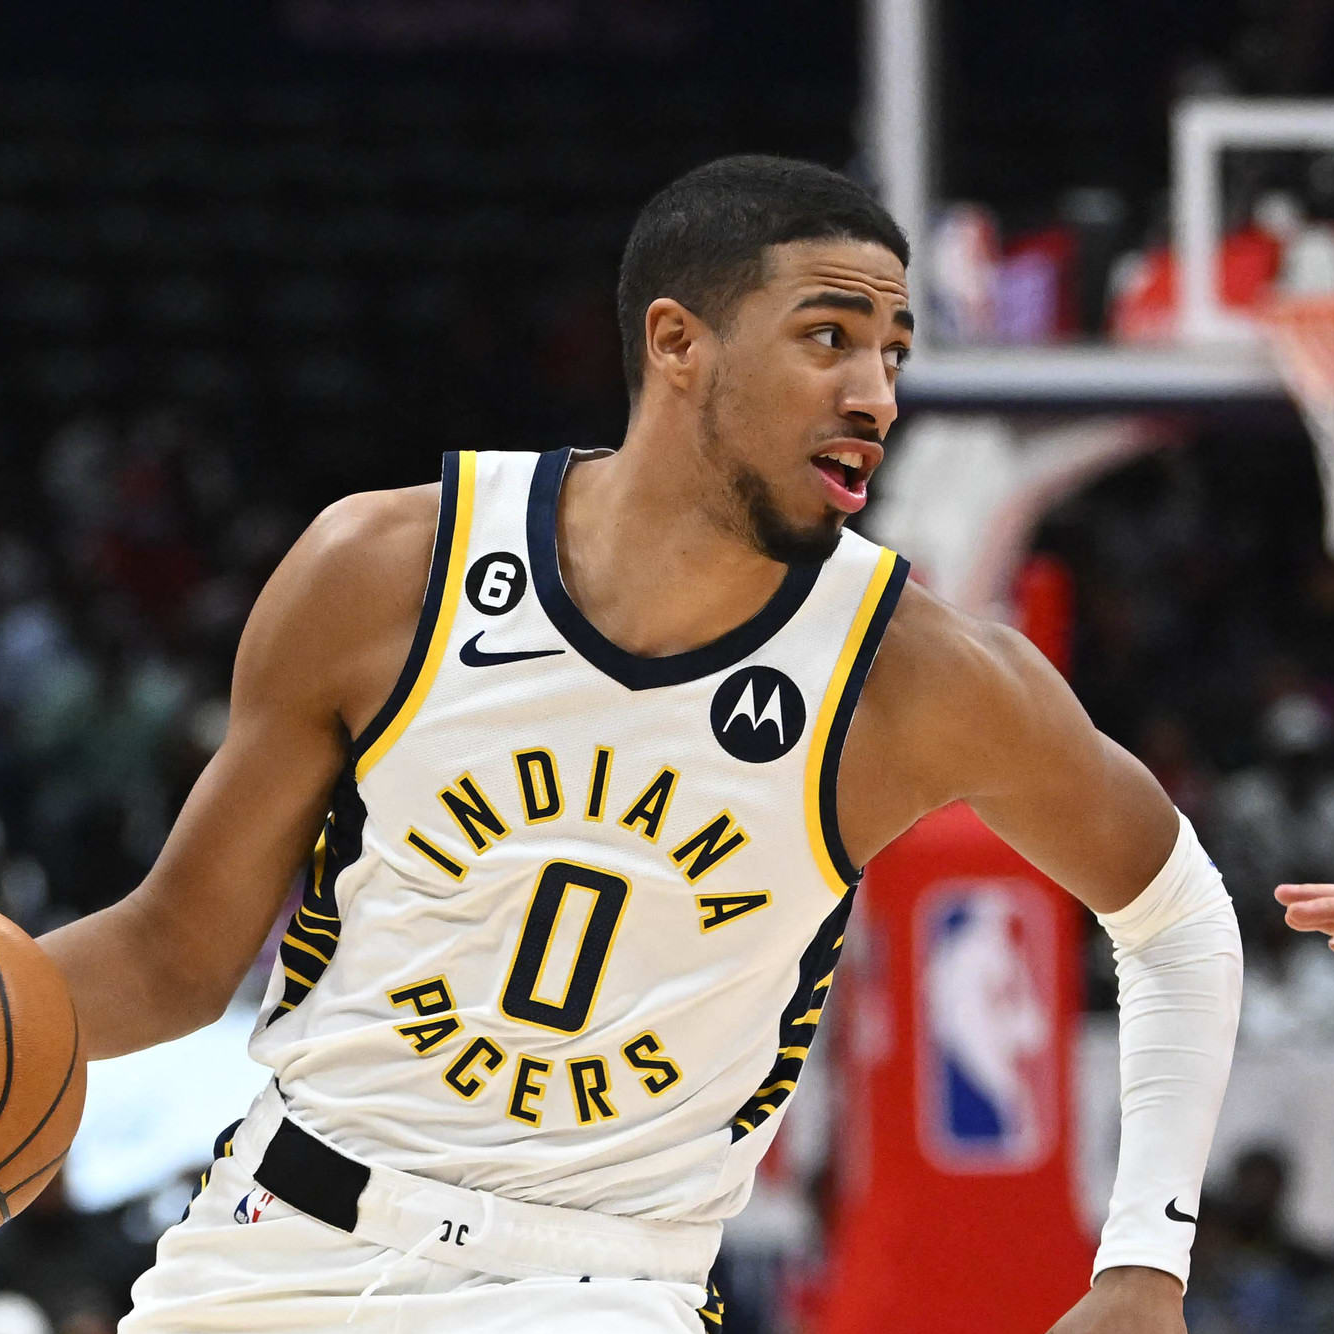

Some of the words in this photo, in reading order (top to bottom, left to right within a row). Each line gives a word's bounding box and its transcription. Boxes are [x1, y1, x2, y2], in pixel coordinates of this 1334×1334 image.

[478, 561, 516, 608] 6
[404, 745, 772, 934] INDIANA
[498, 857, 633, 1037] 0
[386, 973, 683, 1128] PACERS
